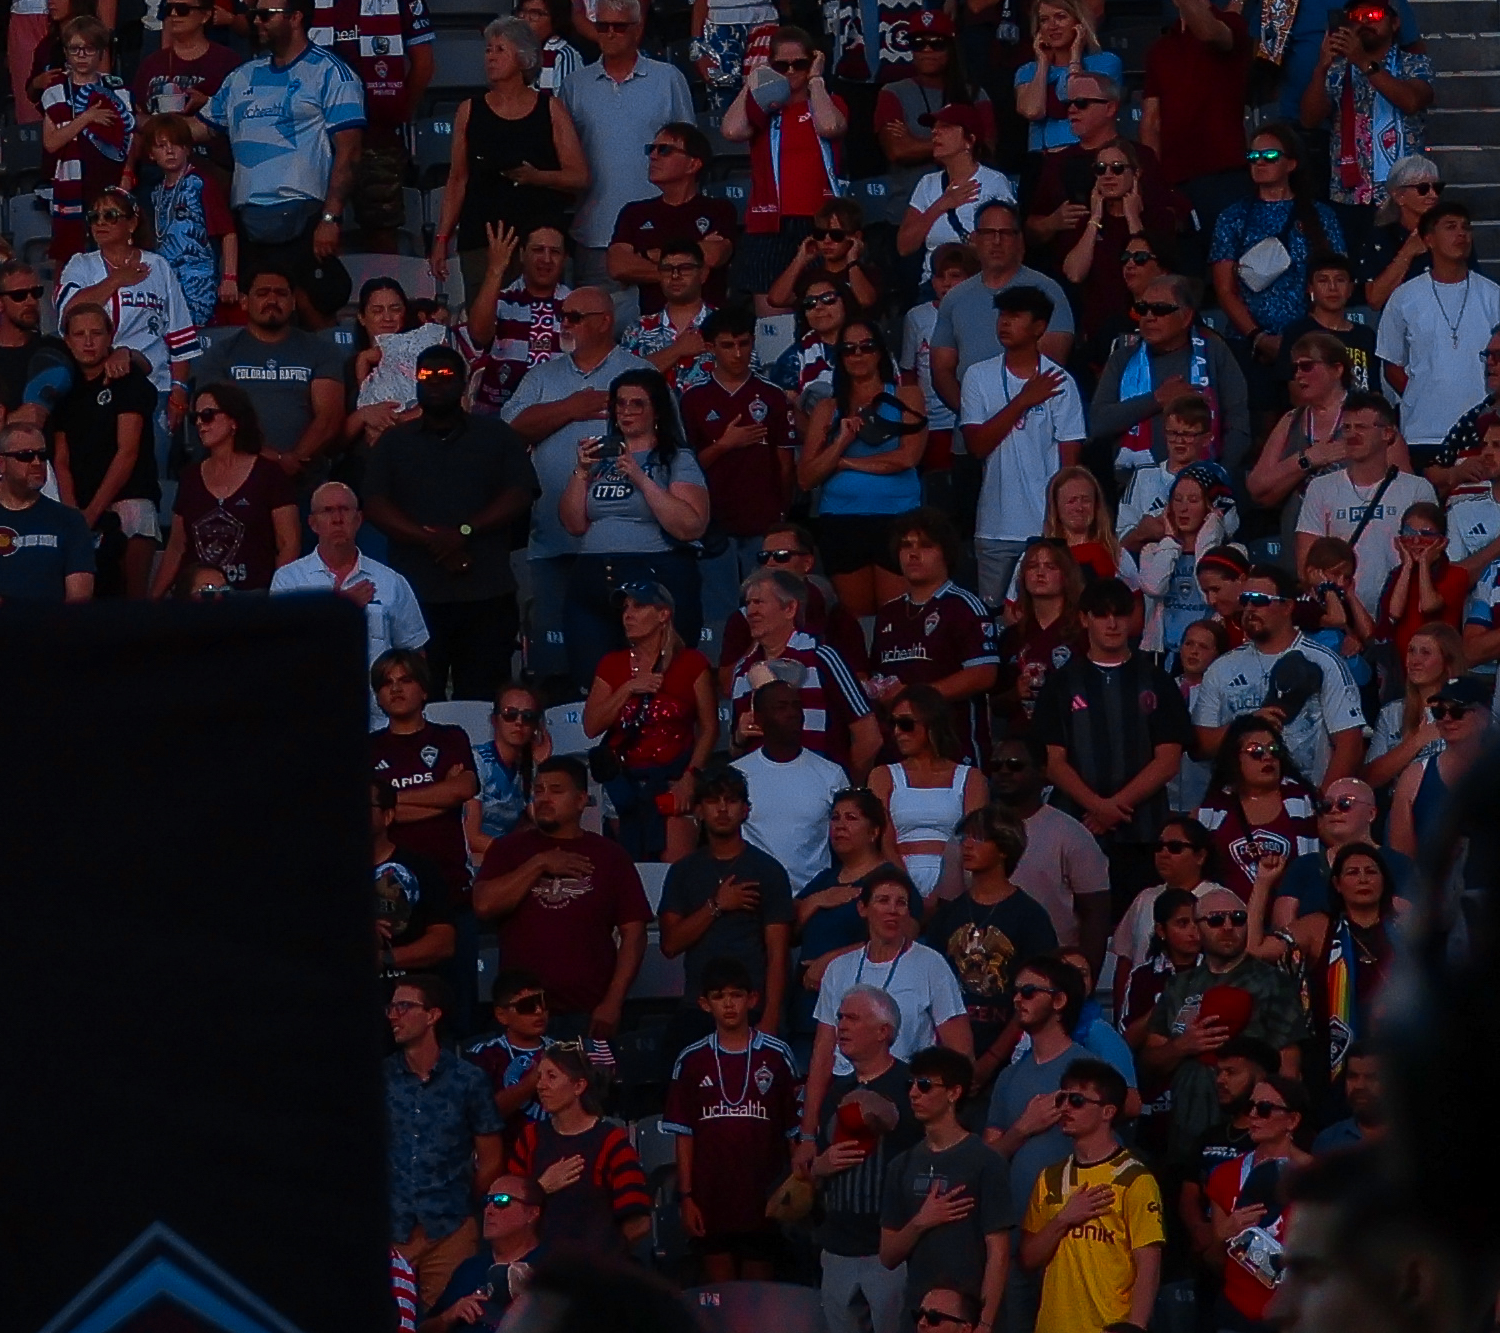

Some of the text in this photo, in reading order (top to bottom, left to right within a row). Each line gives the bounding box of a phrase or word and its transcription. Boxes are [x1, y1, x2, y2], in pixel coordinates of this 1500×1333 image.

[595, 484, 625, 498] 1776
[391, 772, 432, 789] APIDS
[701, 1100, 770, 1121] uchealth
